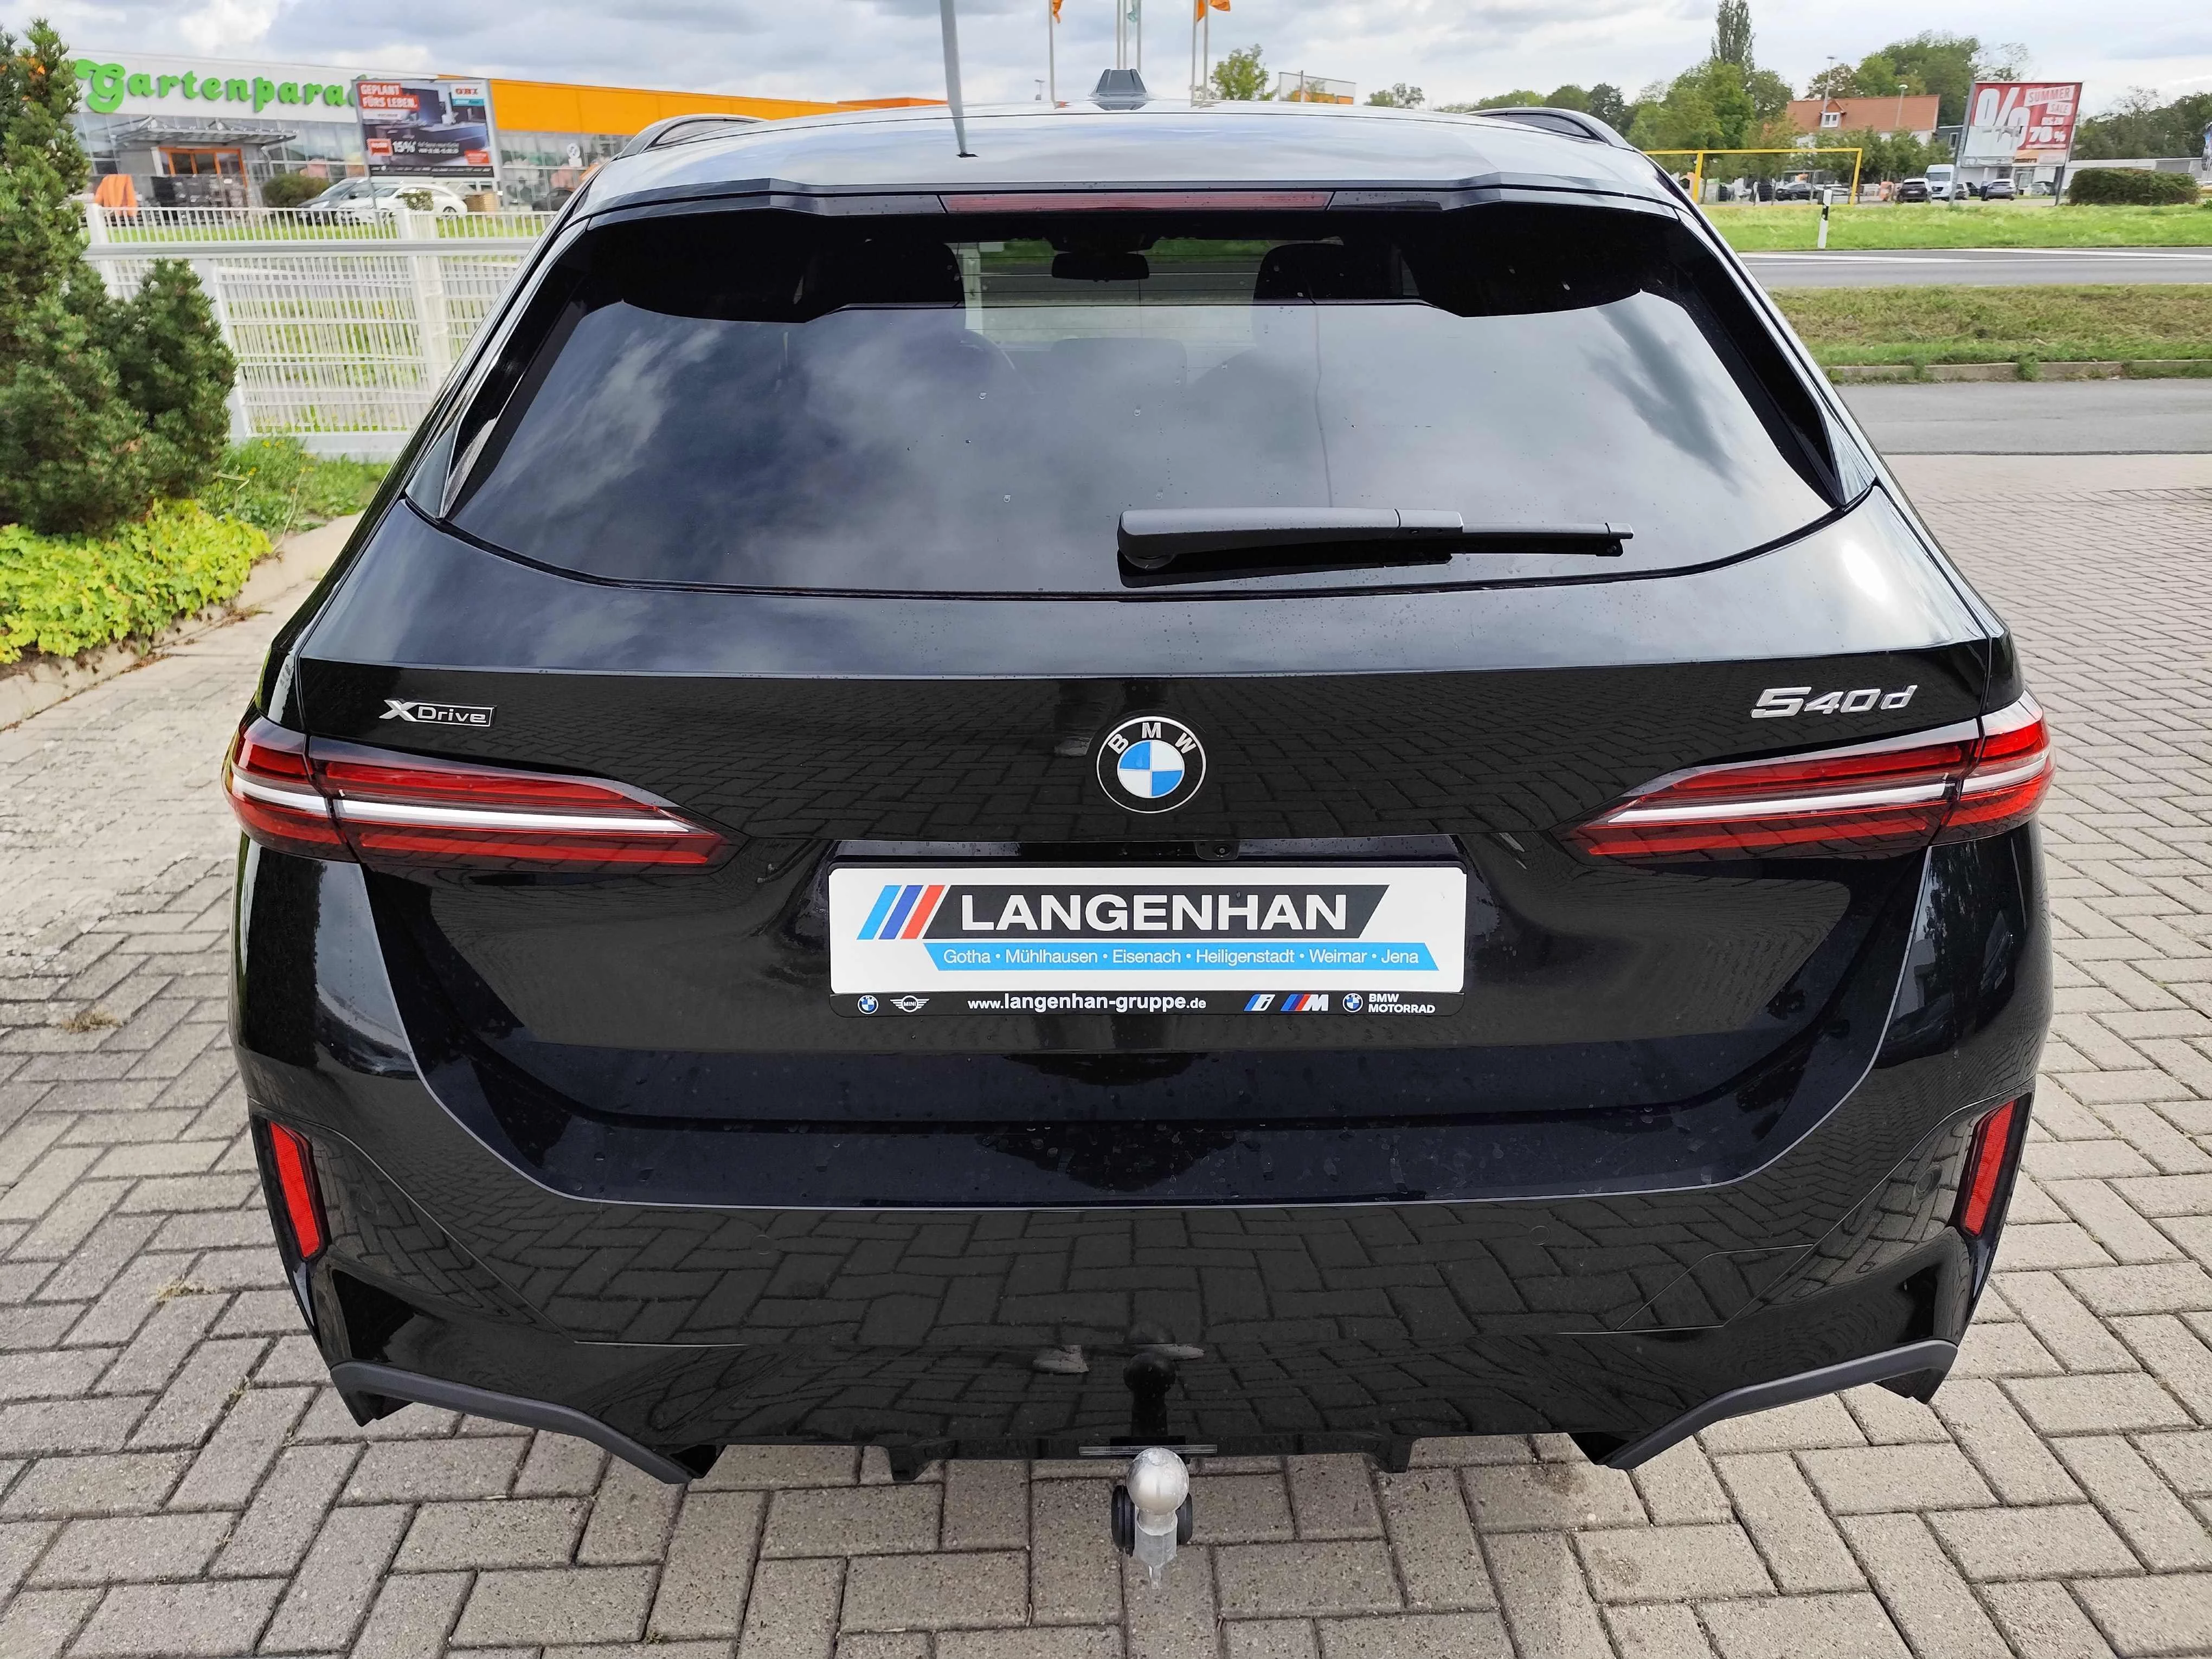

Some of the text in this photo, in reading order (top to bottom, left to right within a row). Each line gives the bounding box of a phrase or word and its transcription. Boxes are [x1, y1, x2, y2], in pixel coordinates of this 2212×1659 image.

[360, 85, 400, 95] GEPLANT
[2028, 88, 2070, 103] SUMMER
[362, 96, 385, 107] FÜRS
[2050, 103, 2068, 113] SALE
[2029, 126, 2052, 143] 70
[1107, 722, 1197, 755] BMW
[962, 895, 1346, 930] LANGENHAN
[943, 949, 1419, 966] Gotha Mühlhausen Eisenach Heiligenstadt Weimar Jena
[967, 993, 1206, 1013] www.langenhan-gruppe.de
[1368, 993, 1399, 1002] BMW
[1368, 1004, 1436, 1013] MOTORRAD
